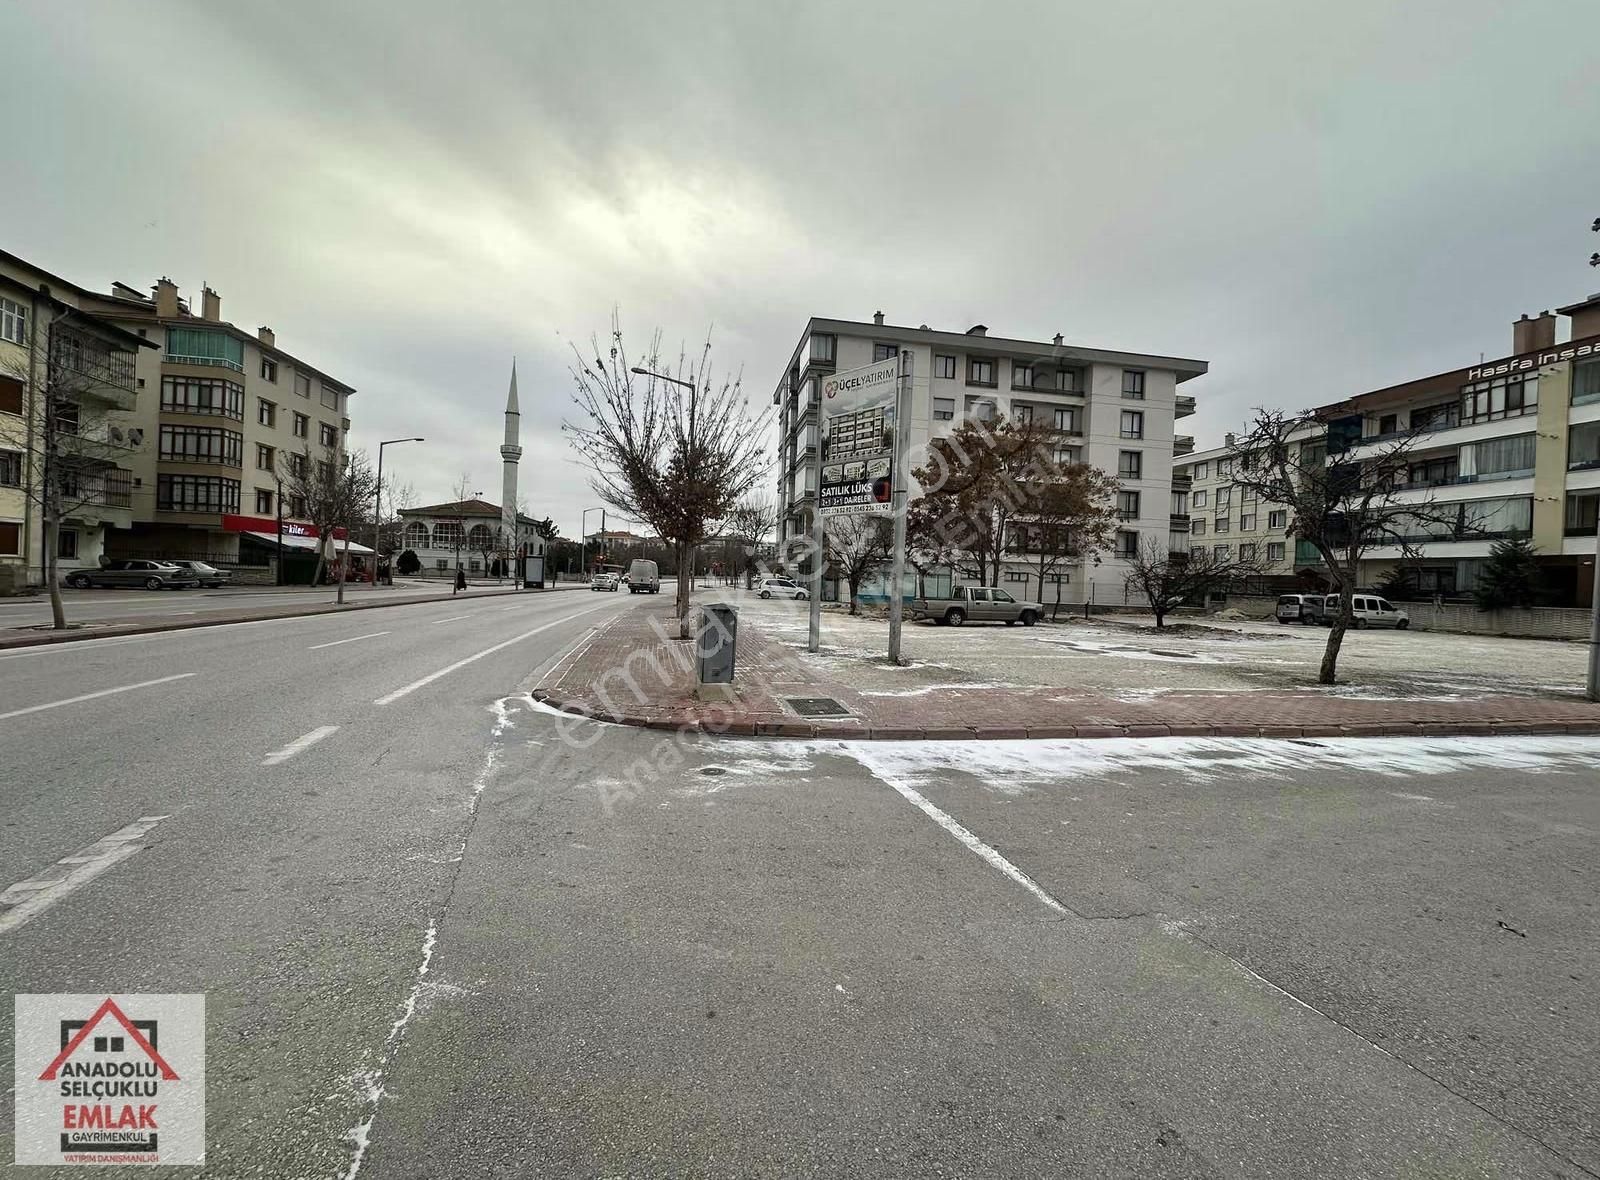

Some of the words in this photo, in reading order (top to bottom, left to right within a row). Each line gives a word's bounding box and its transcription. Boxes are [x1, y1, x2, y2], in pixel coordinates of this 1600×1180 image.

[1468, 359, 1533, 380] Hasfa
[821, 486, 850, 497] SATILIK
[851, 481, 873, 494] LÜKS
